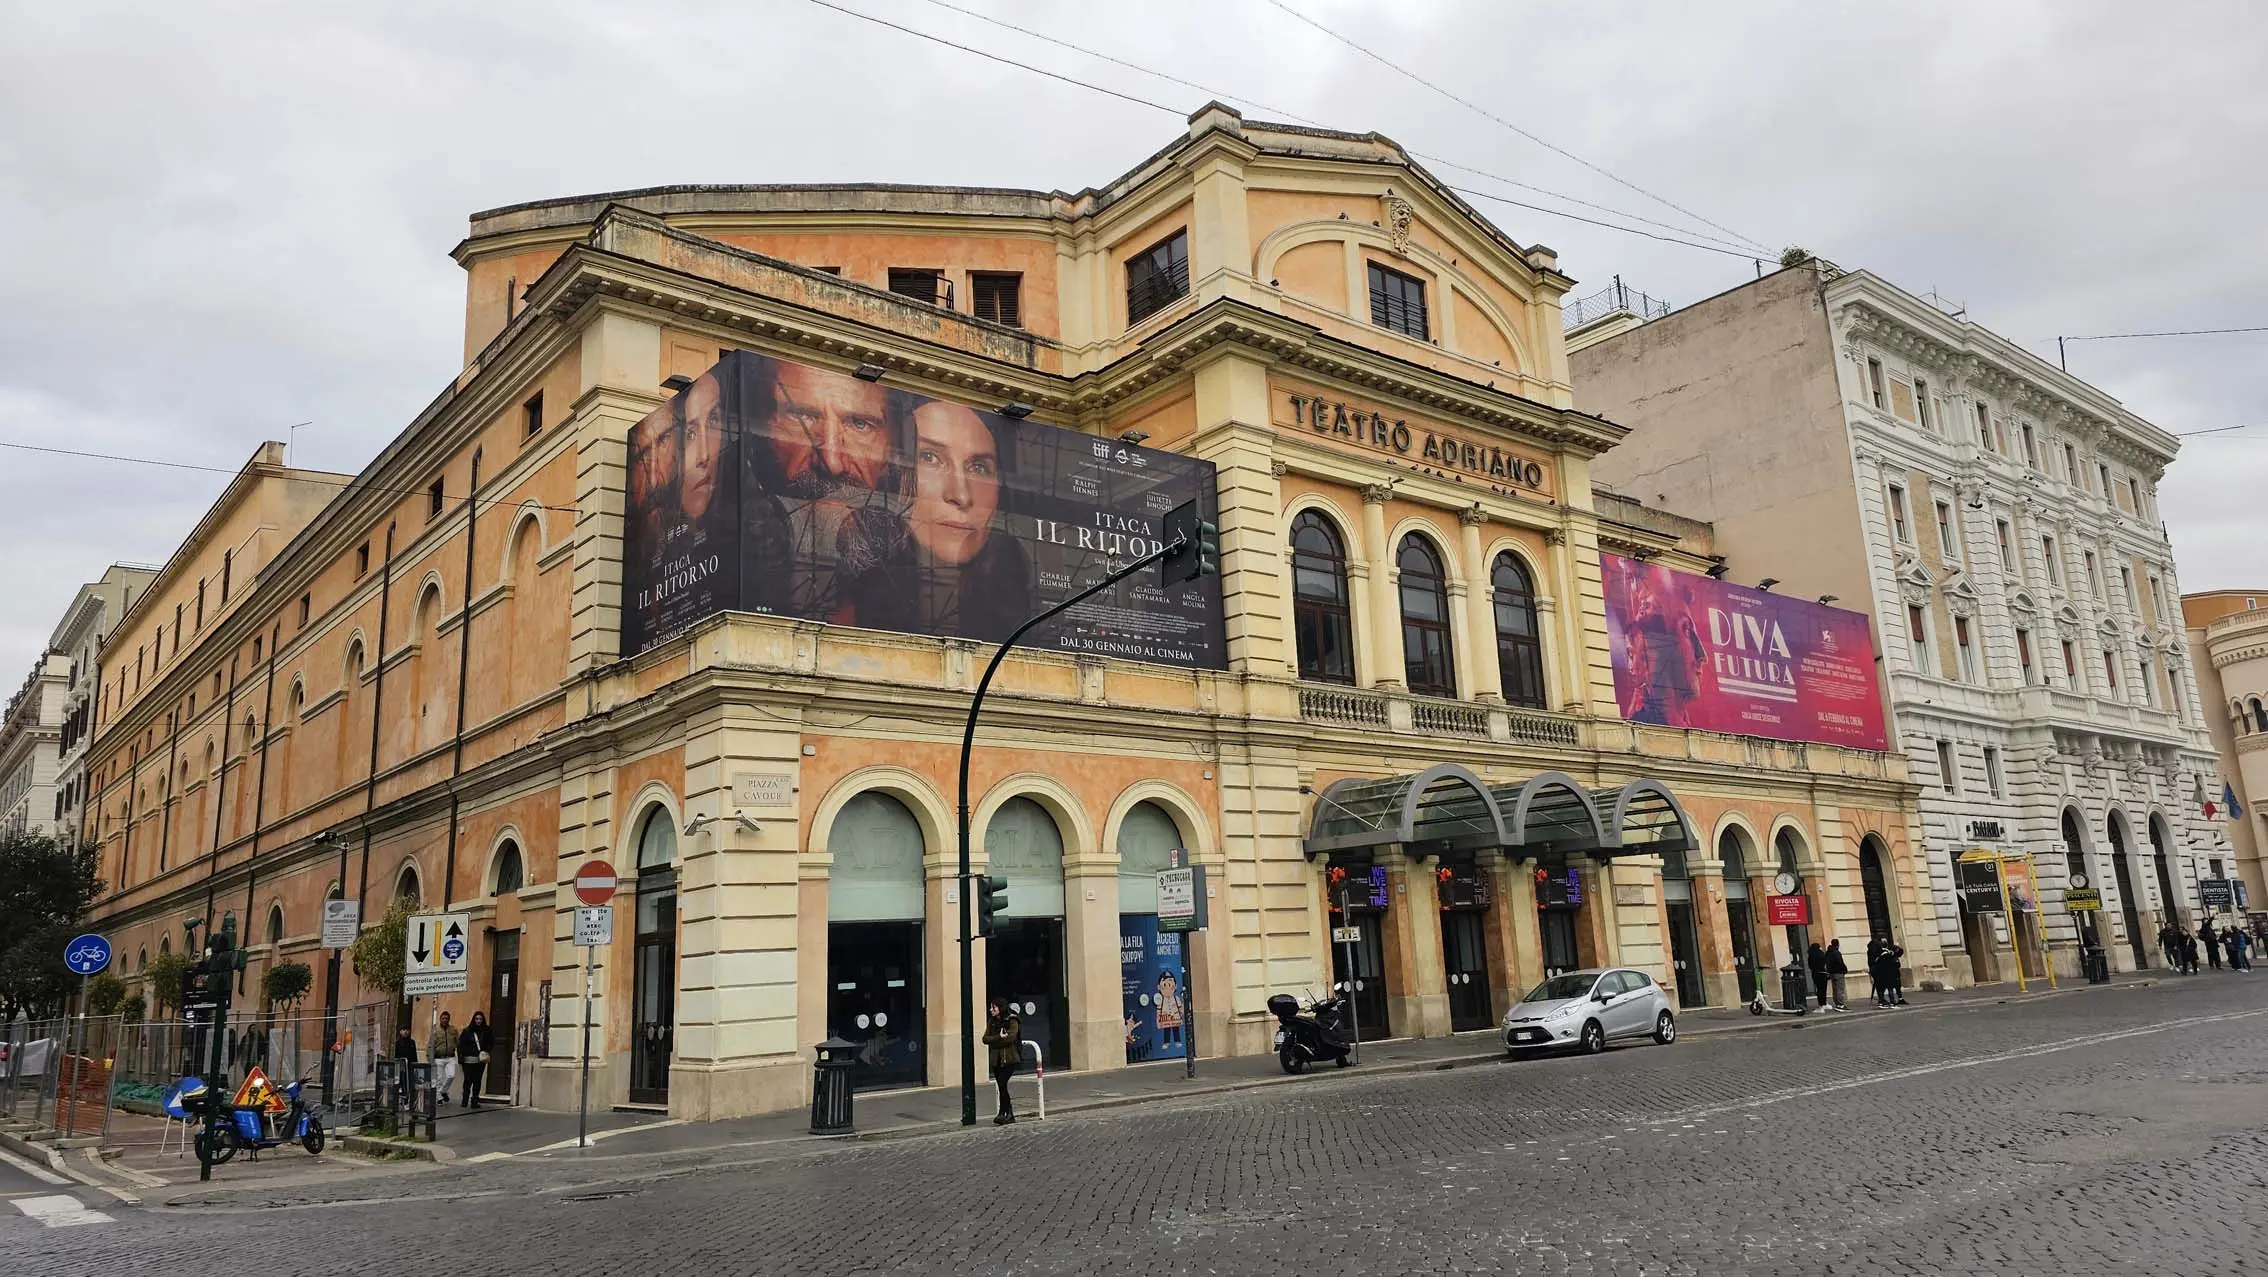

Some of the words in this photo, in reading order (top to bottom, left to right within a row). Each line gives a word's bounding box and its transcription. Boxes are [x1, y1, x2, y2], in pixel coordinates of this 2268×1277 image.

[1290, 396, 1412, 452] TEATRO
[1424, 432, 1543, 488] ADRIANO
[1092, 442, 1109, 459] tiff
[1095, 512, 1152, 536] ITACA
[1035, 518, 1066, 545] IL
[1077, 526, 1164, 558] RITOR
[664, 554, 691, 577] ITACA
[638, 590, 652, 610] IL
[655, 554, 719, 601] RITORNO
[1040, 571, 1070, 582] CHARLIE
[1039, 579, 1072, 590] PLUMMER
[1136, 586, 1164, 596] CLAUDIO
[1129, 592, 1170, 604] SANTAMARIA
[1182, 594, 1206, 602] ANGELA
[1182, 601, 1206, 610] MOLINA
[1708, 608, 1792, 659] DIVA
[1060, 636, 1080, 648] DAL
[1082, 639, 1094, 649] 30
[1096, 641, 1142, 655] GENNAIO
[1144, 647, 1156, 657] AL
[1157, 648, 1194, 661] CINEMA
[1714, 652, 1796, 686] FUTURA
[748, 780, 778, 788] PIAZZA
[744, 792, 782, 800] CAVOUR
[1966, 886, 1992, 894] CENTURY
[1132, 936, 1144, 948] FILA
[1122, 951, 1143, 963] SKIPPY!
[404, 977, 433, 985] controllo
[434, 975, 466, 983] elettronico
[426, 982, 465, 992] preferenziale
